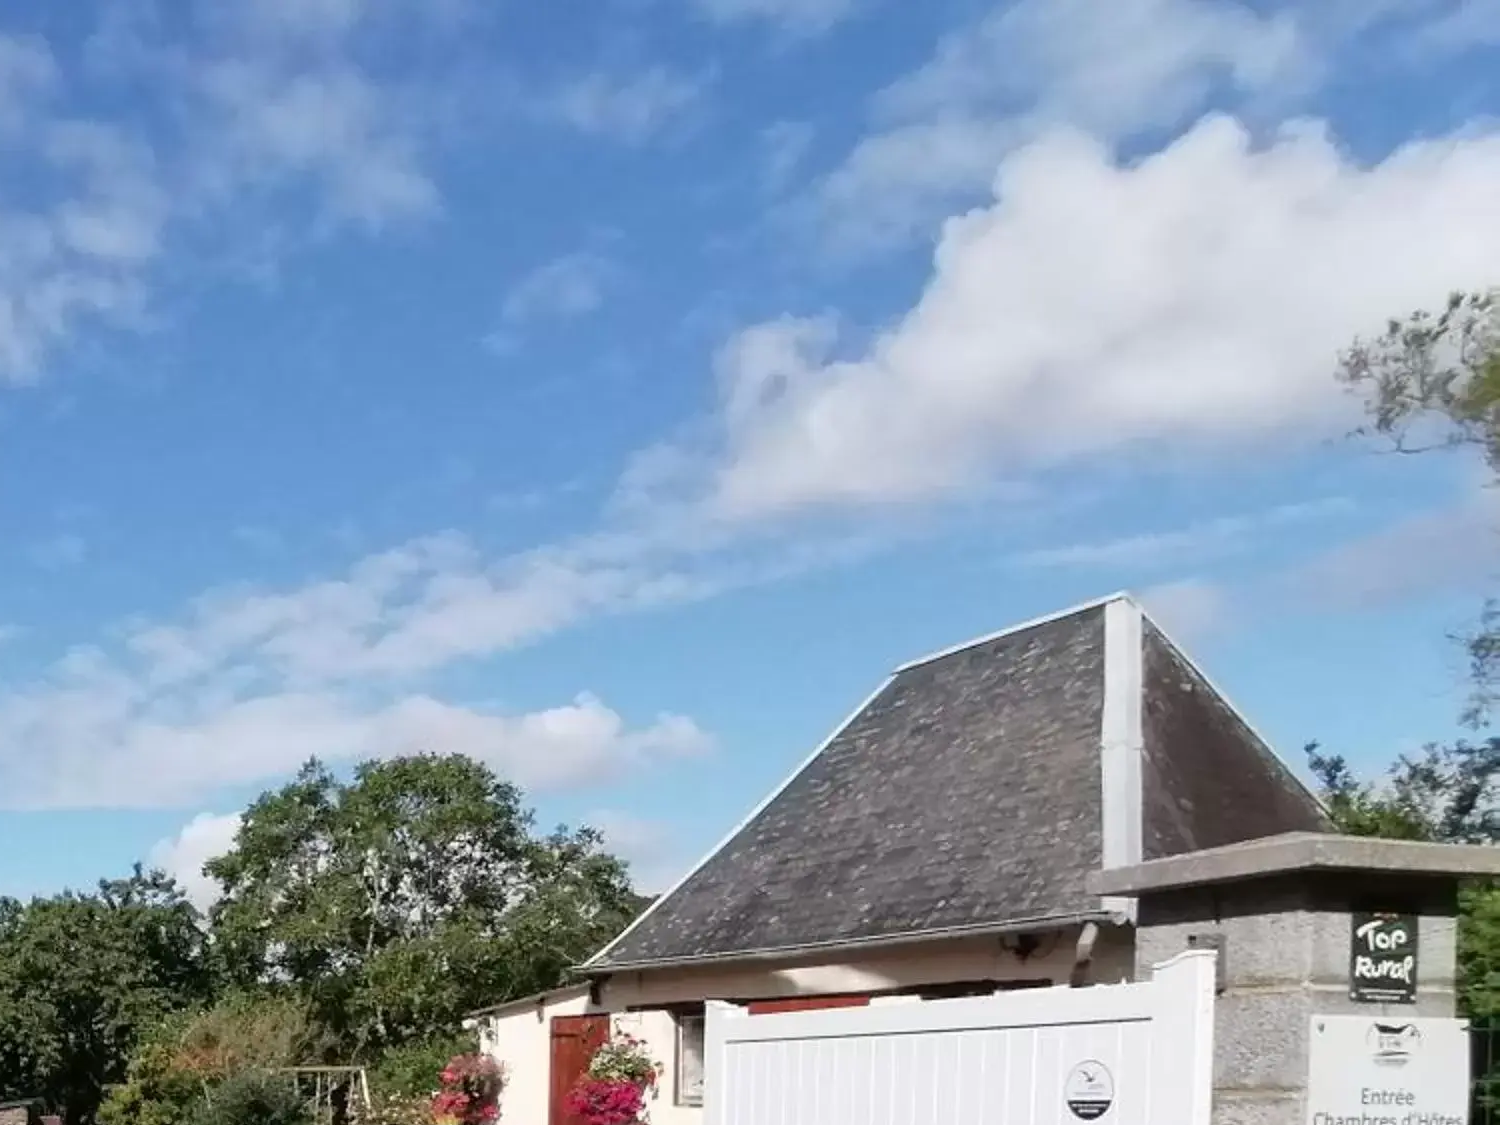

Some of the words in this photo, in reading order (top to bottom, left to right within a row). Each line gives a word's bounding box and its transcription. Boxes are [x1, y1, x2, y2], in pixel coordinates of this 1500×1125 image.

[1356, 920, 1407, 951] Top
[1355, 954, 1414, 984] Rural
[1360, 1087, 1416, 1106] Entrée
